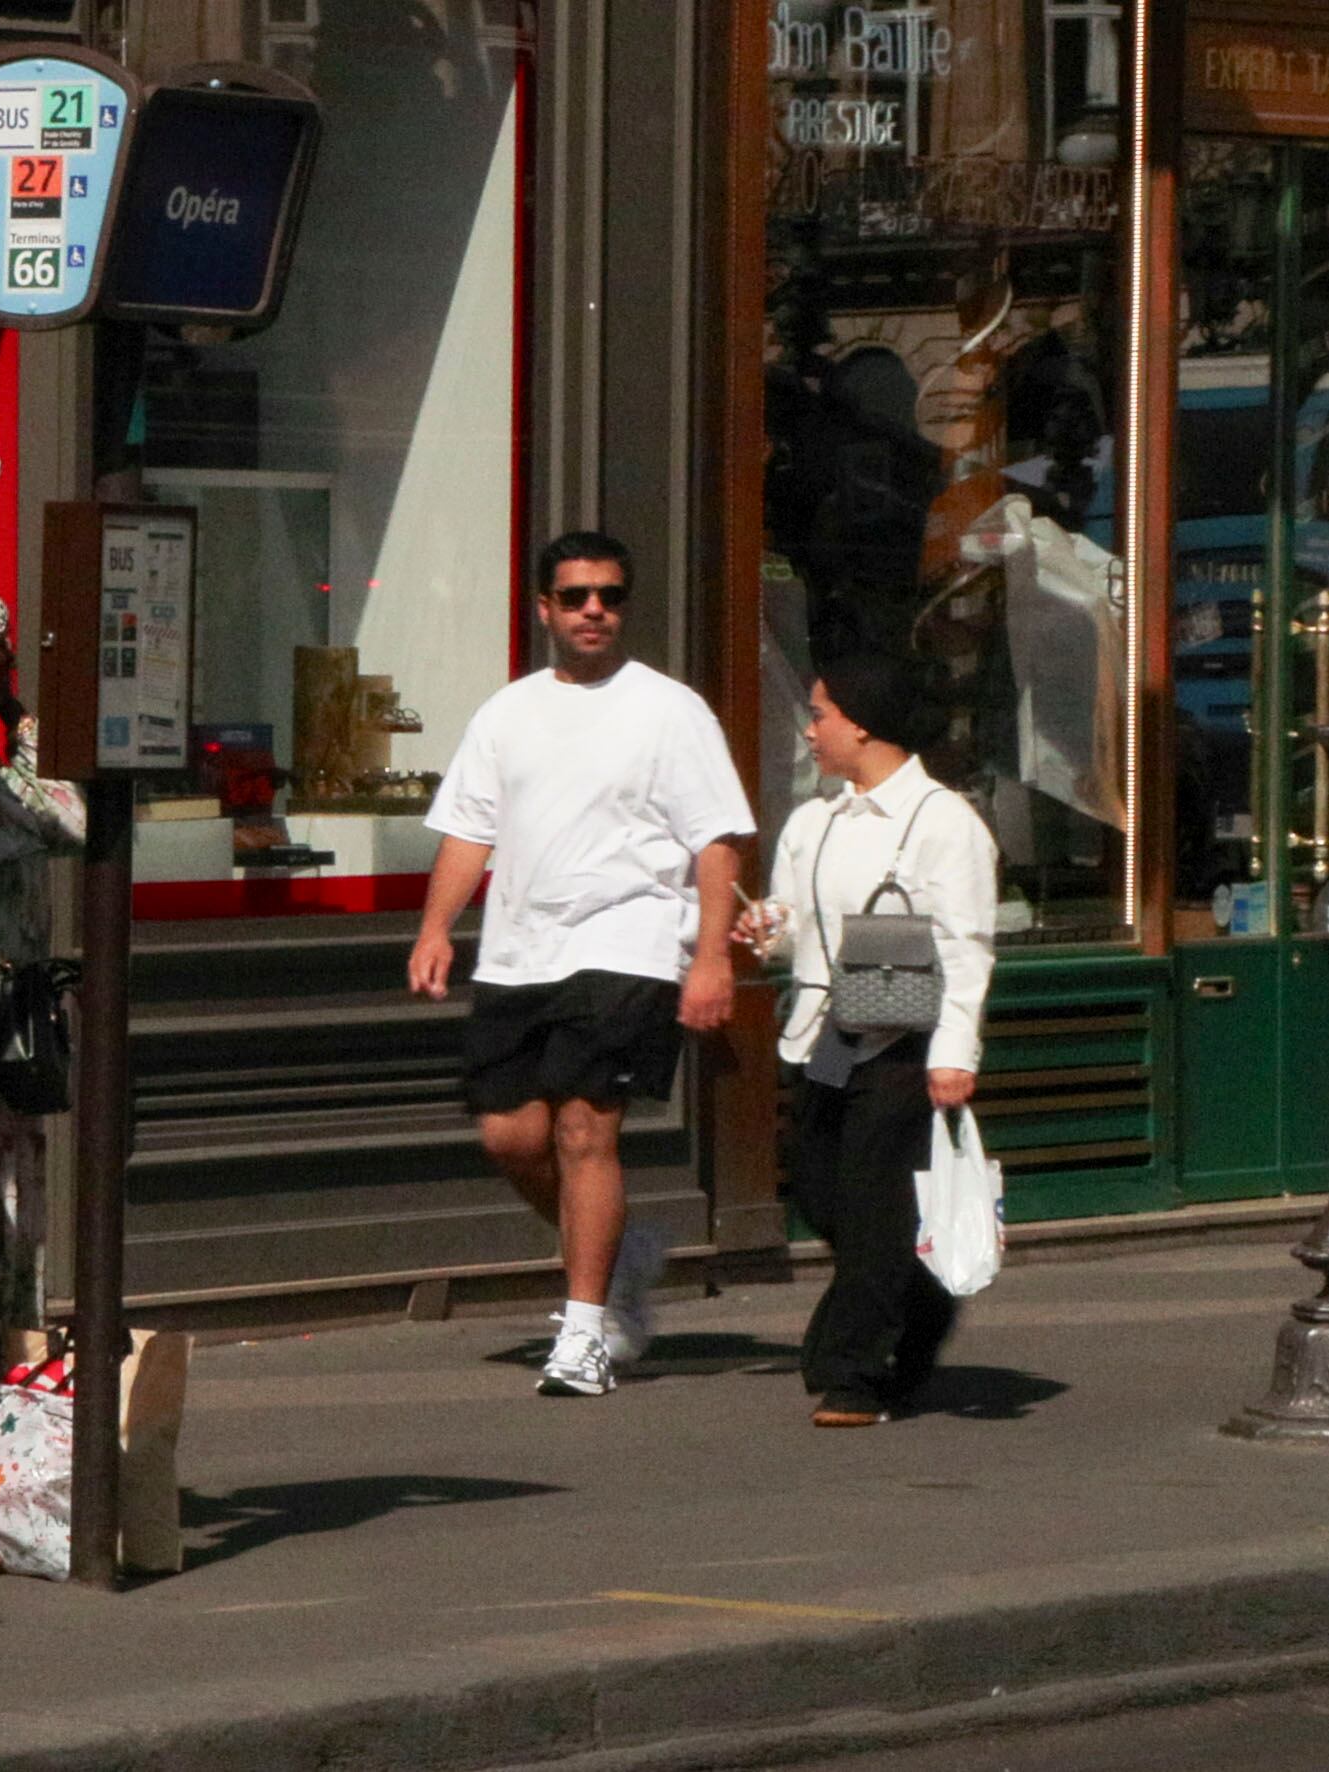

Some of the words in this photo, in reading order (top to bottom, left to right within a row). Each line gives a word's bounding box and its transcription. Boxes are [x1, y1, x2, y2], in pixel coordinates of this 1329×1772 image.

[49, 89, 84, 124] 21
[17, 159, 57, 193] 27
[166, 186, 240, 230] Opéra
[10, 232, 62, 245] Terminus
[14, 250, 55, 286] 66
[109, 547, 134, 572] BUS
